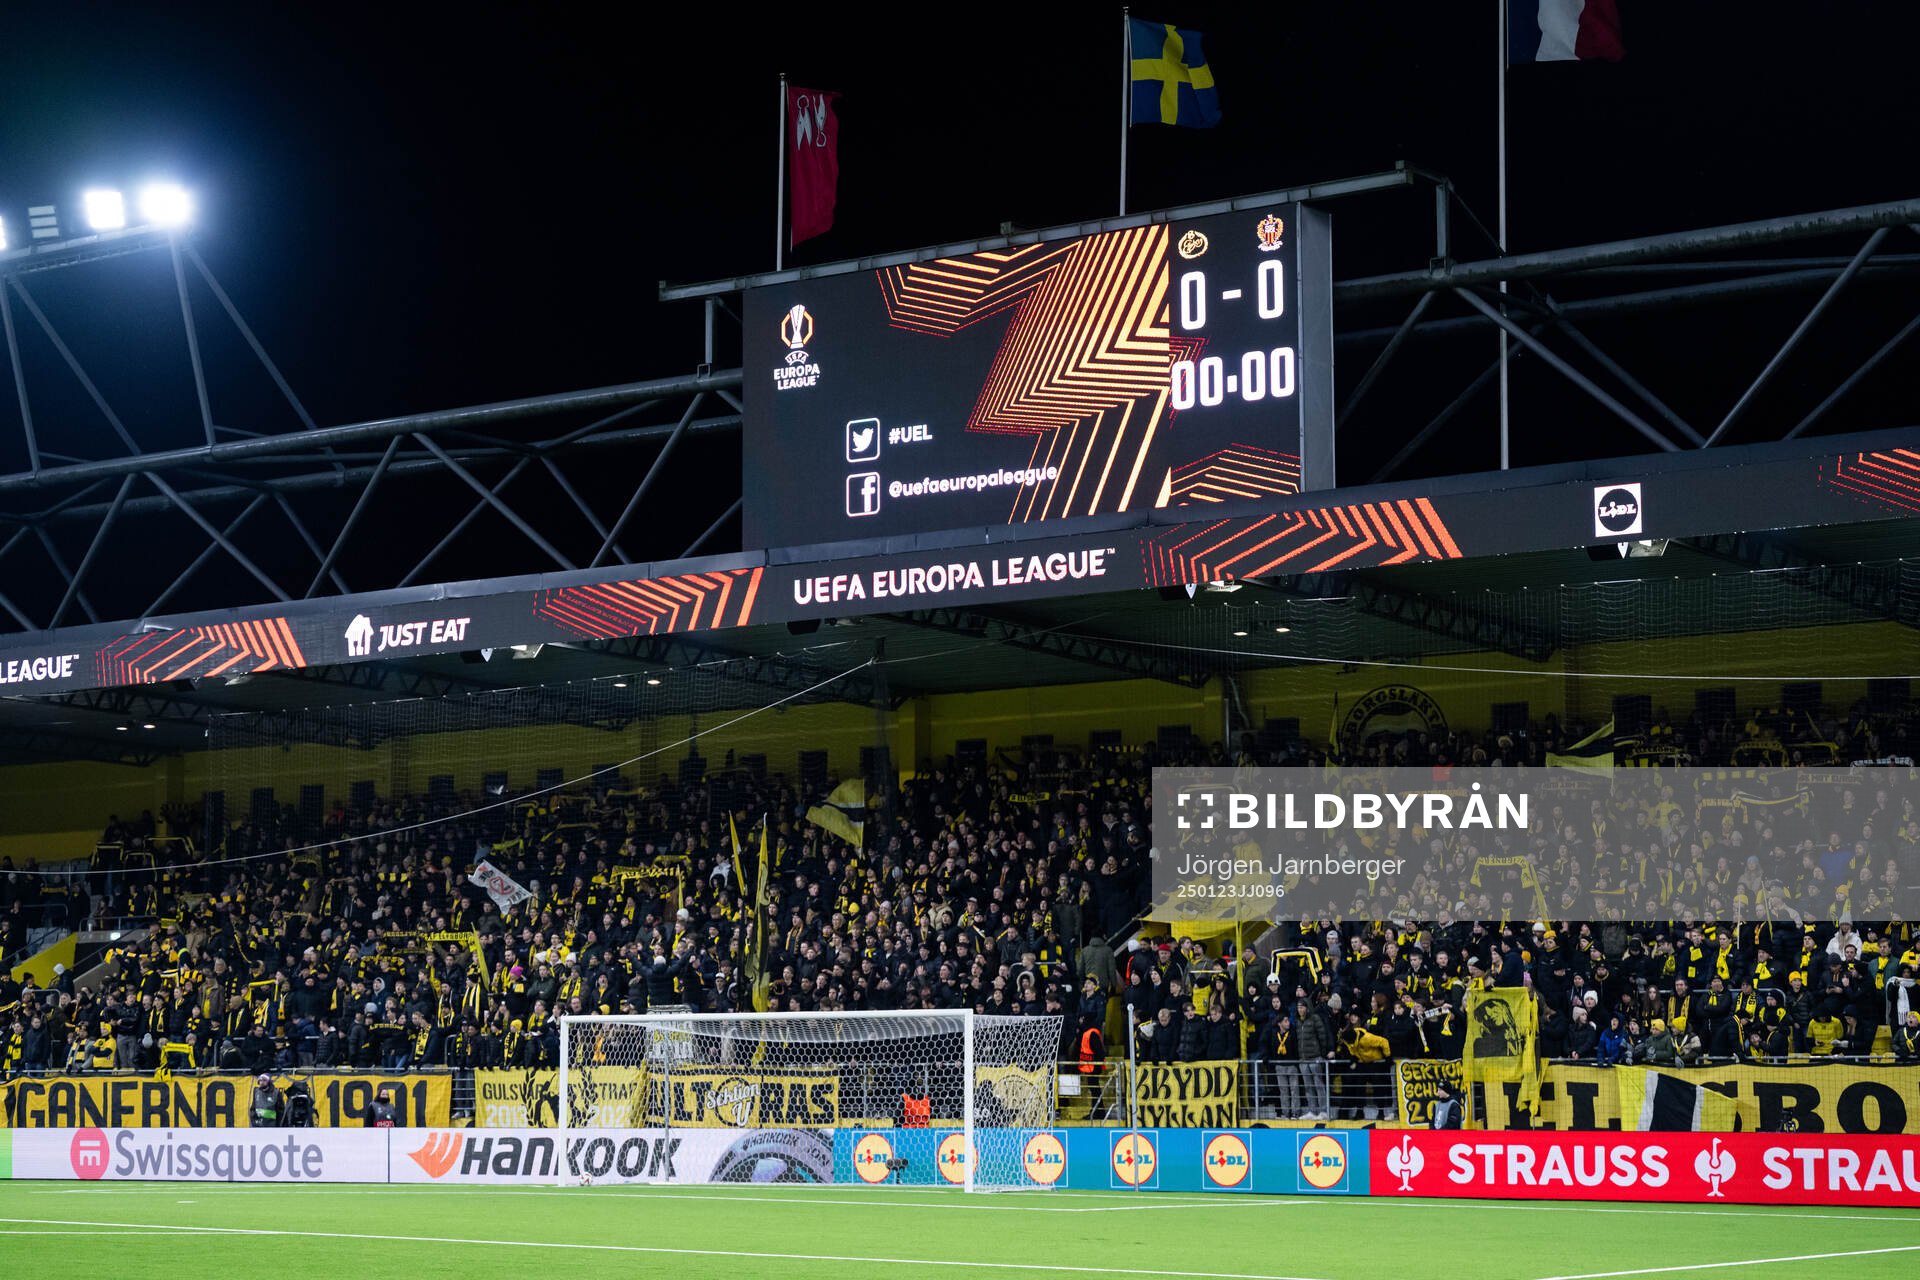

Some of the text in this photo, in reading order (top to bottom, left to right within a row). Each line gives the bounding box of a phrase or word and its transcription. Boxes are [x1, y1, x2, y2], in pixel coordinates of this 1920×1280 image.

[1181, 271, 1206, 330] 0
[1257, 259, 1284, 319] 0
[773, 364, 820, 380] EUROPA
[889, 424, 933, 445] #UEL
[889, 466, 1058, 498] @uefaeuropaleague
[794, 574, 866, 605] UEFA
[873, 562, 984, 598] EUROPA
[379, 618, 470, 652] JUST EAT
[115, 1129, 323, 1181] Swissquote
[1448, 1143, 1670, 1187] STRAUSS
